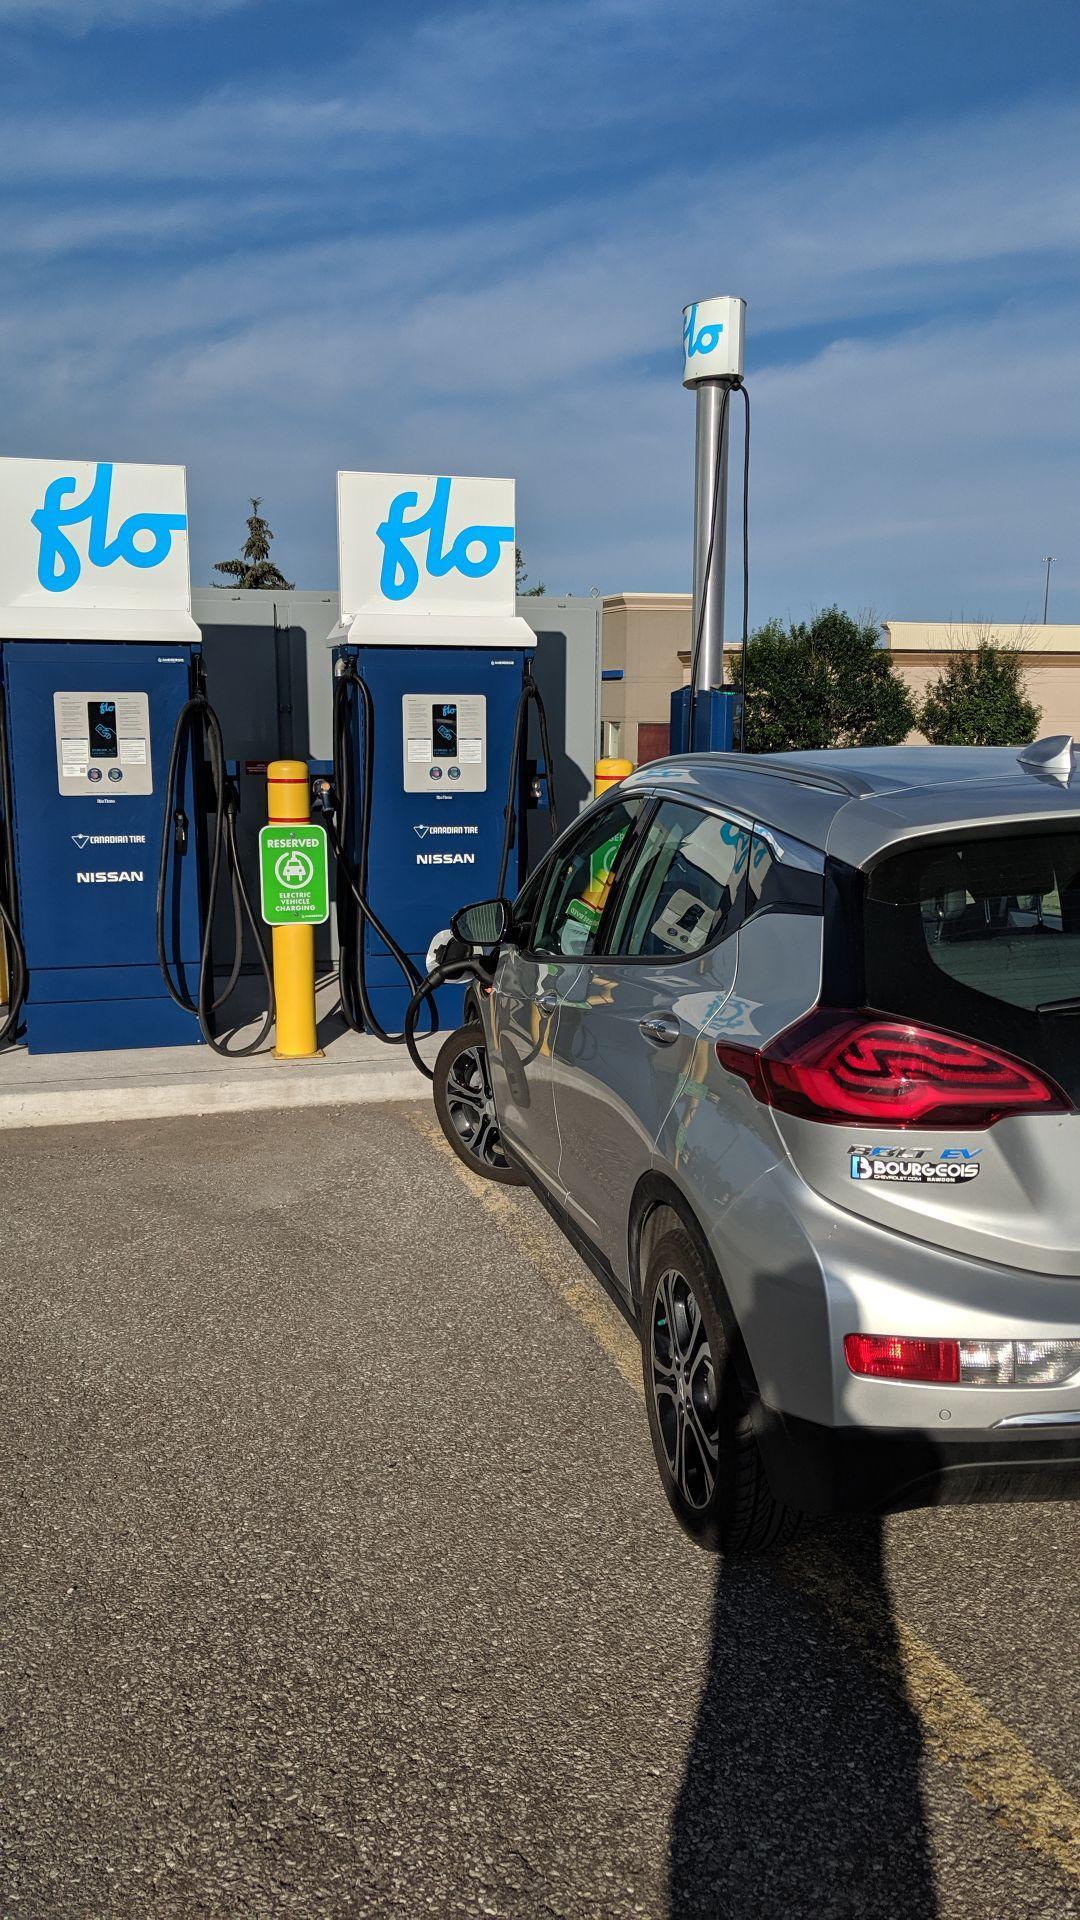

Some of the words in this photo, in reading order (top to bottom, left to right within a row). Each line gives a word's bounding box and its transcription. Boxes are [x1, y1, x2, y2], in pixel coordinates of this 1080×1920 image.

[30, 463, 187, 592] flo
[376, 477, 515, 601] flo
[99, 702, 116, 715] flo
[441, 705, 457, 717] flo
[430, 826, 463, 835] CANADIAN
[464, 826, 479, 834] TIRE
[90, 835, 128, 844] CANADIAN
[129, 835, 146, 844] TIRE
[266, 838, 320, 849] RESERVED
[416, 853, 475, 865] NISSAN
[76, 871, 144, 883] NISSAN
[275, 904, 316, 912] CHARGING
[940, 1147, 983, 1160] EV
[873, 1160, 980, 1178] BOURGEOIS
